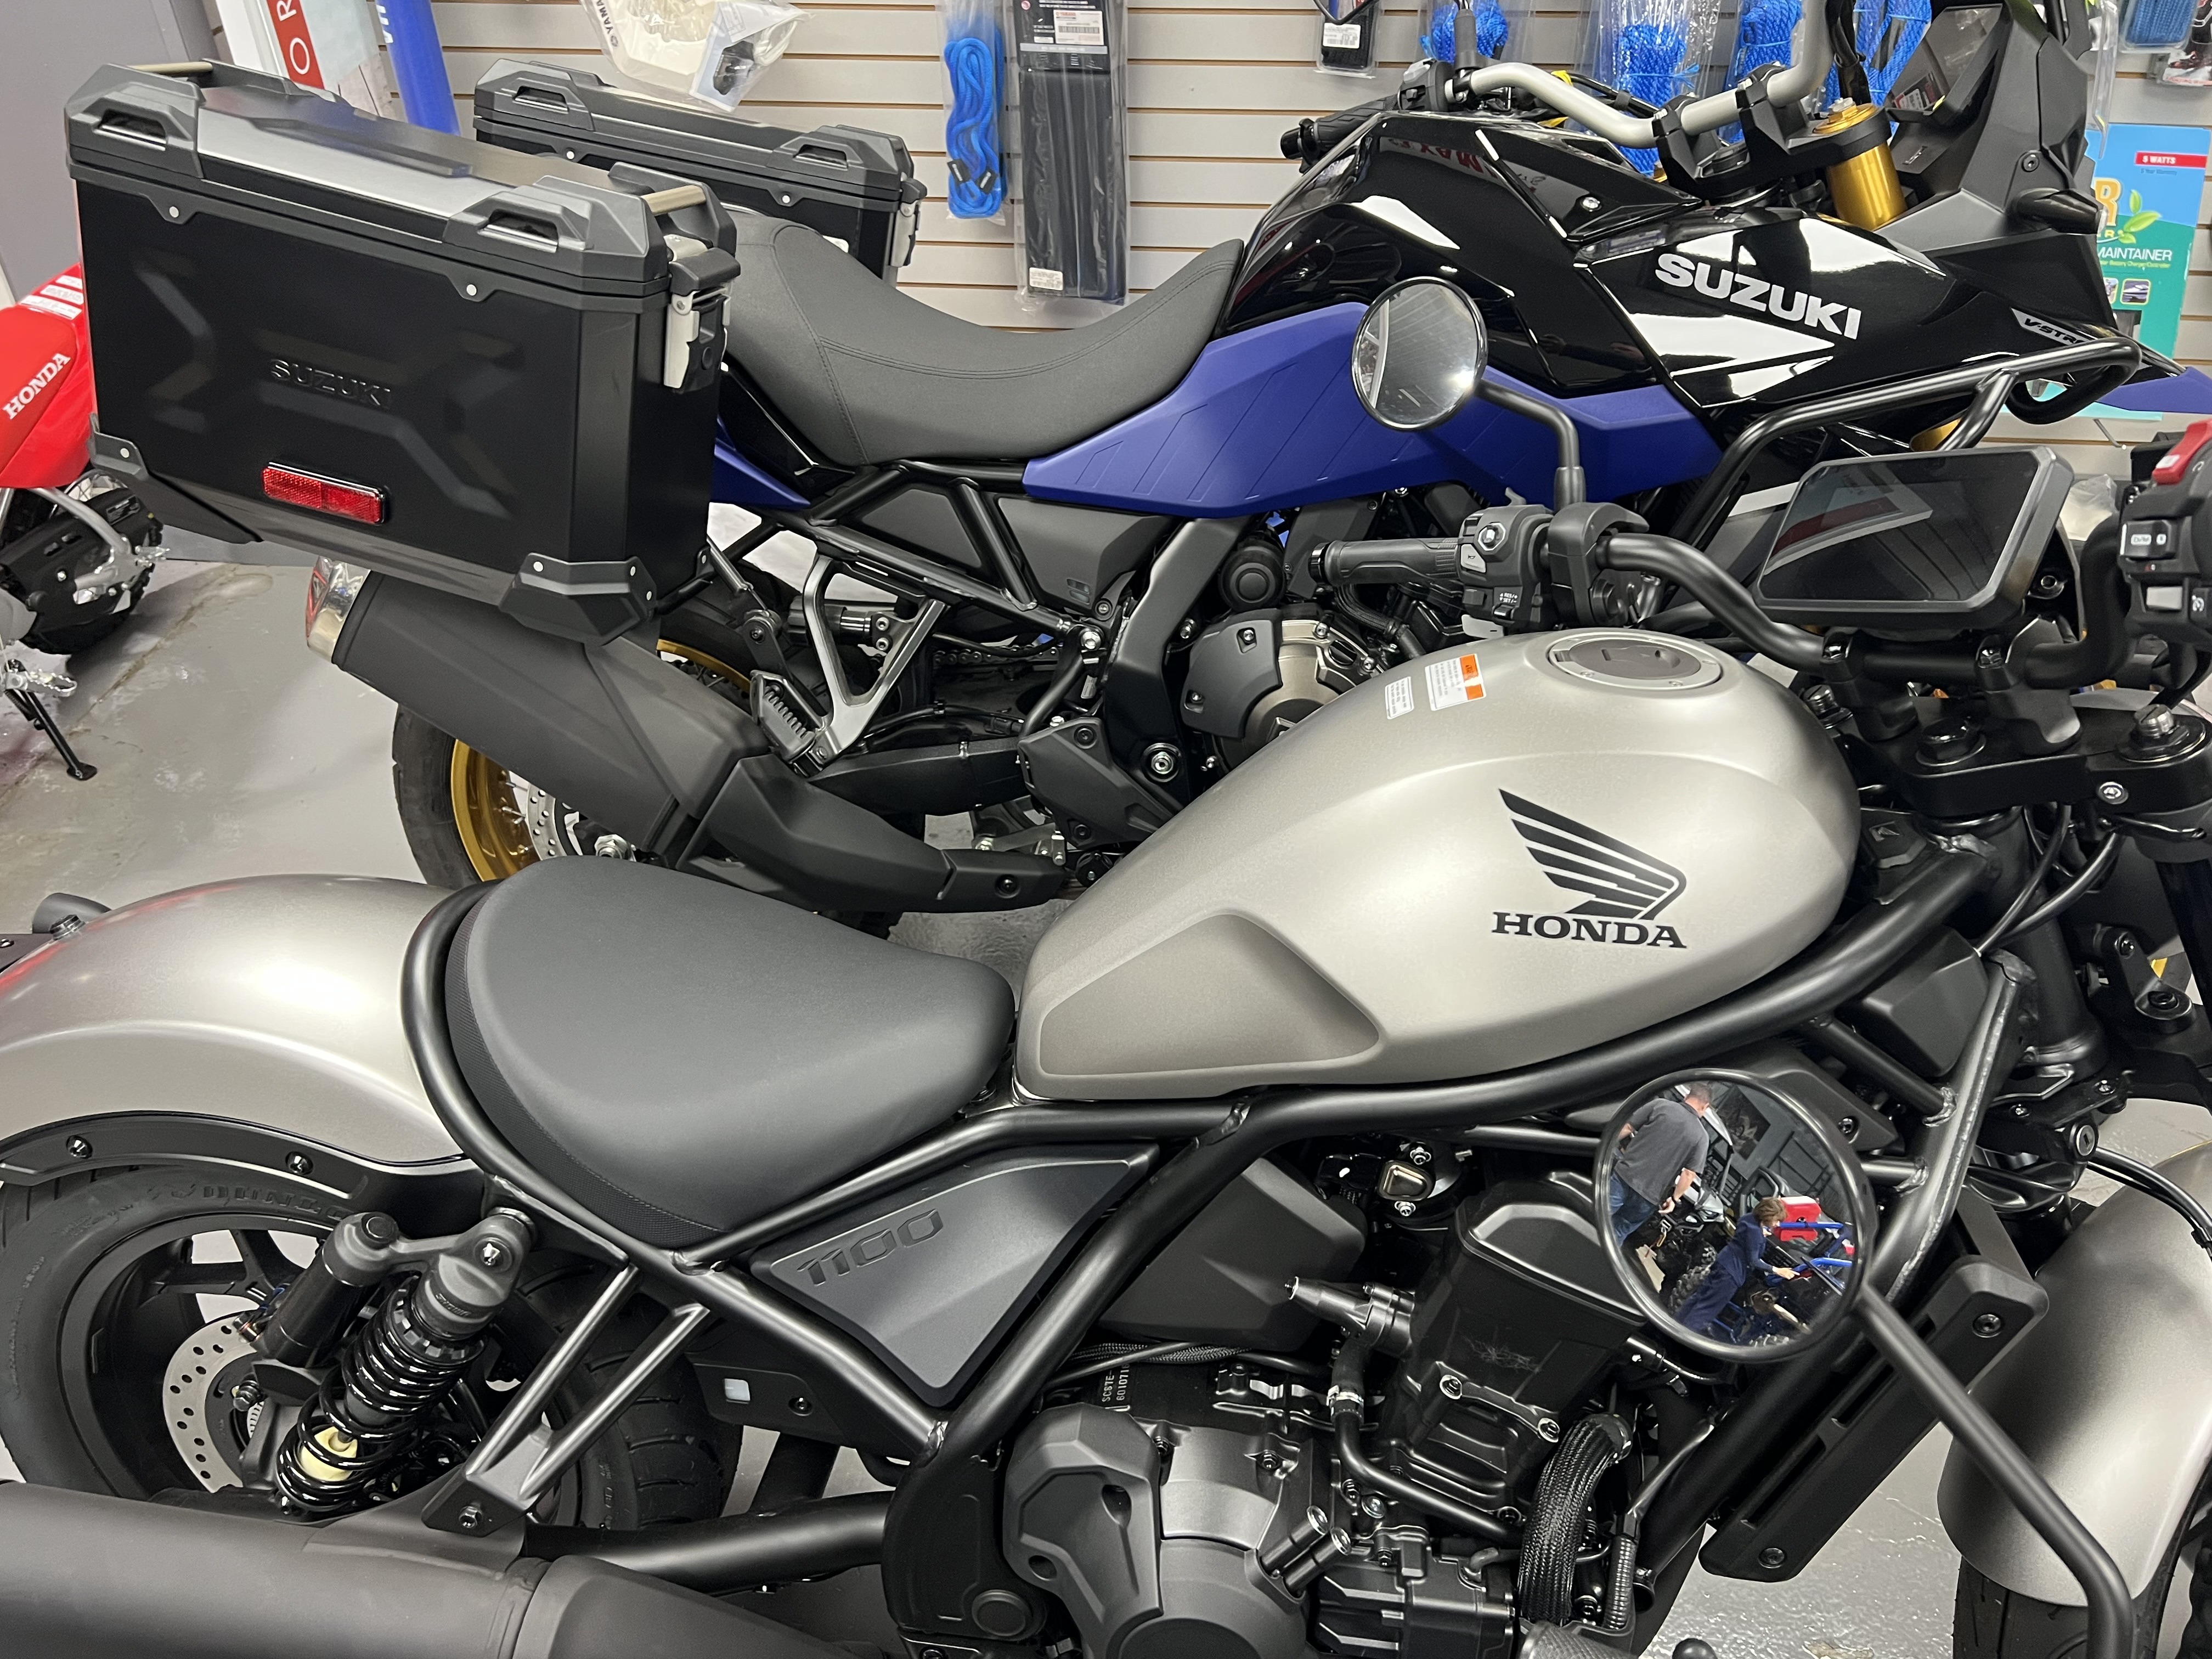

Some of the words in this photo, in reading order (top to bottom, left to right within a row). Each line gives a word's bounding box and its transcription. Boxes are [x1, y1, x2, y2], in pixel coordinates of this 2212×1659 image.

[2149, 156, 2176, 164] WATTS
[1655, 253, 1862, 340] SUZUKI
[2, 352, 72, 420] HONDA
[269, 359, 392, 410] SUZUKI
[1491, 911, 1688, 949] HONDA
[797, 1208, 944, 1286] 1100
